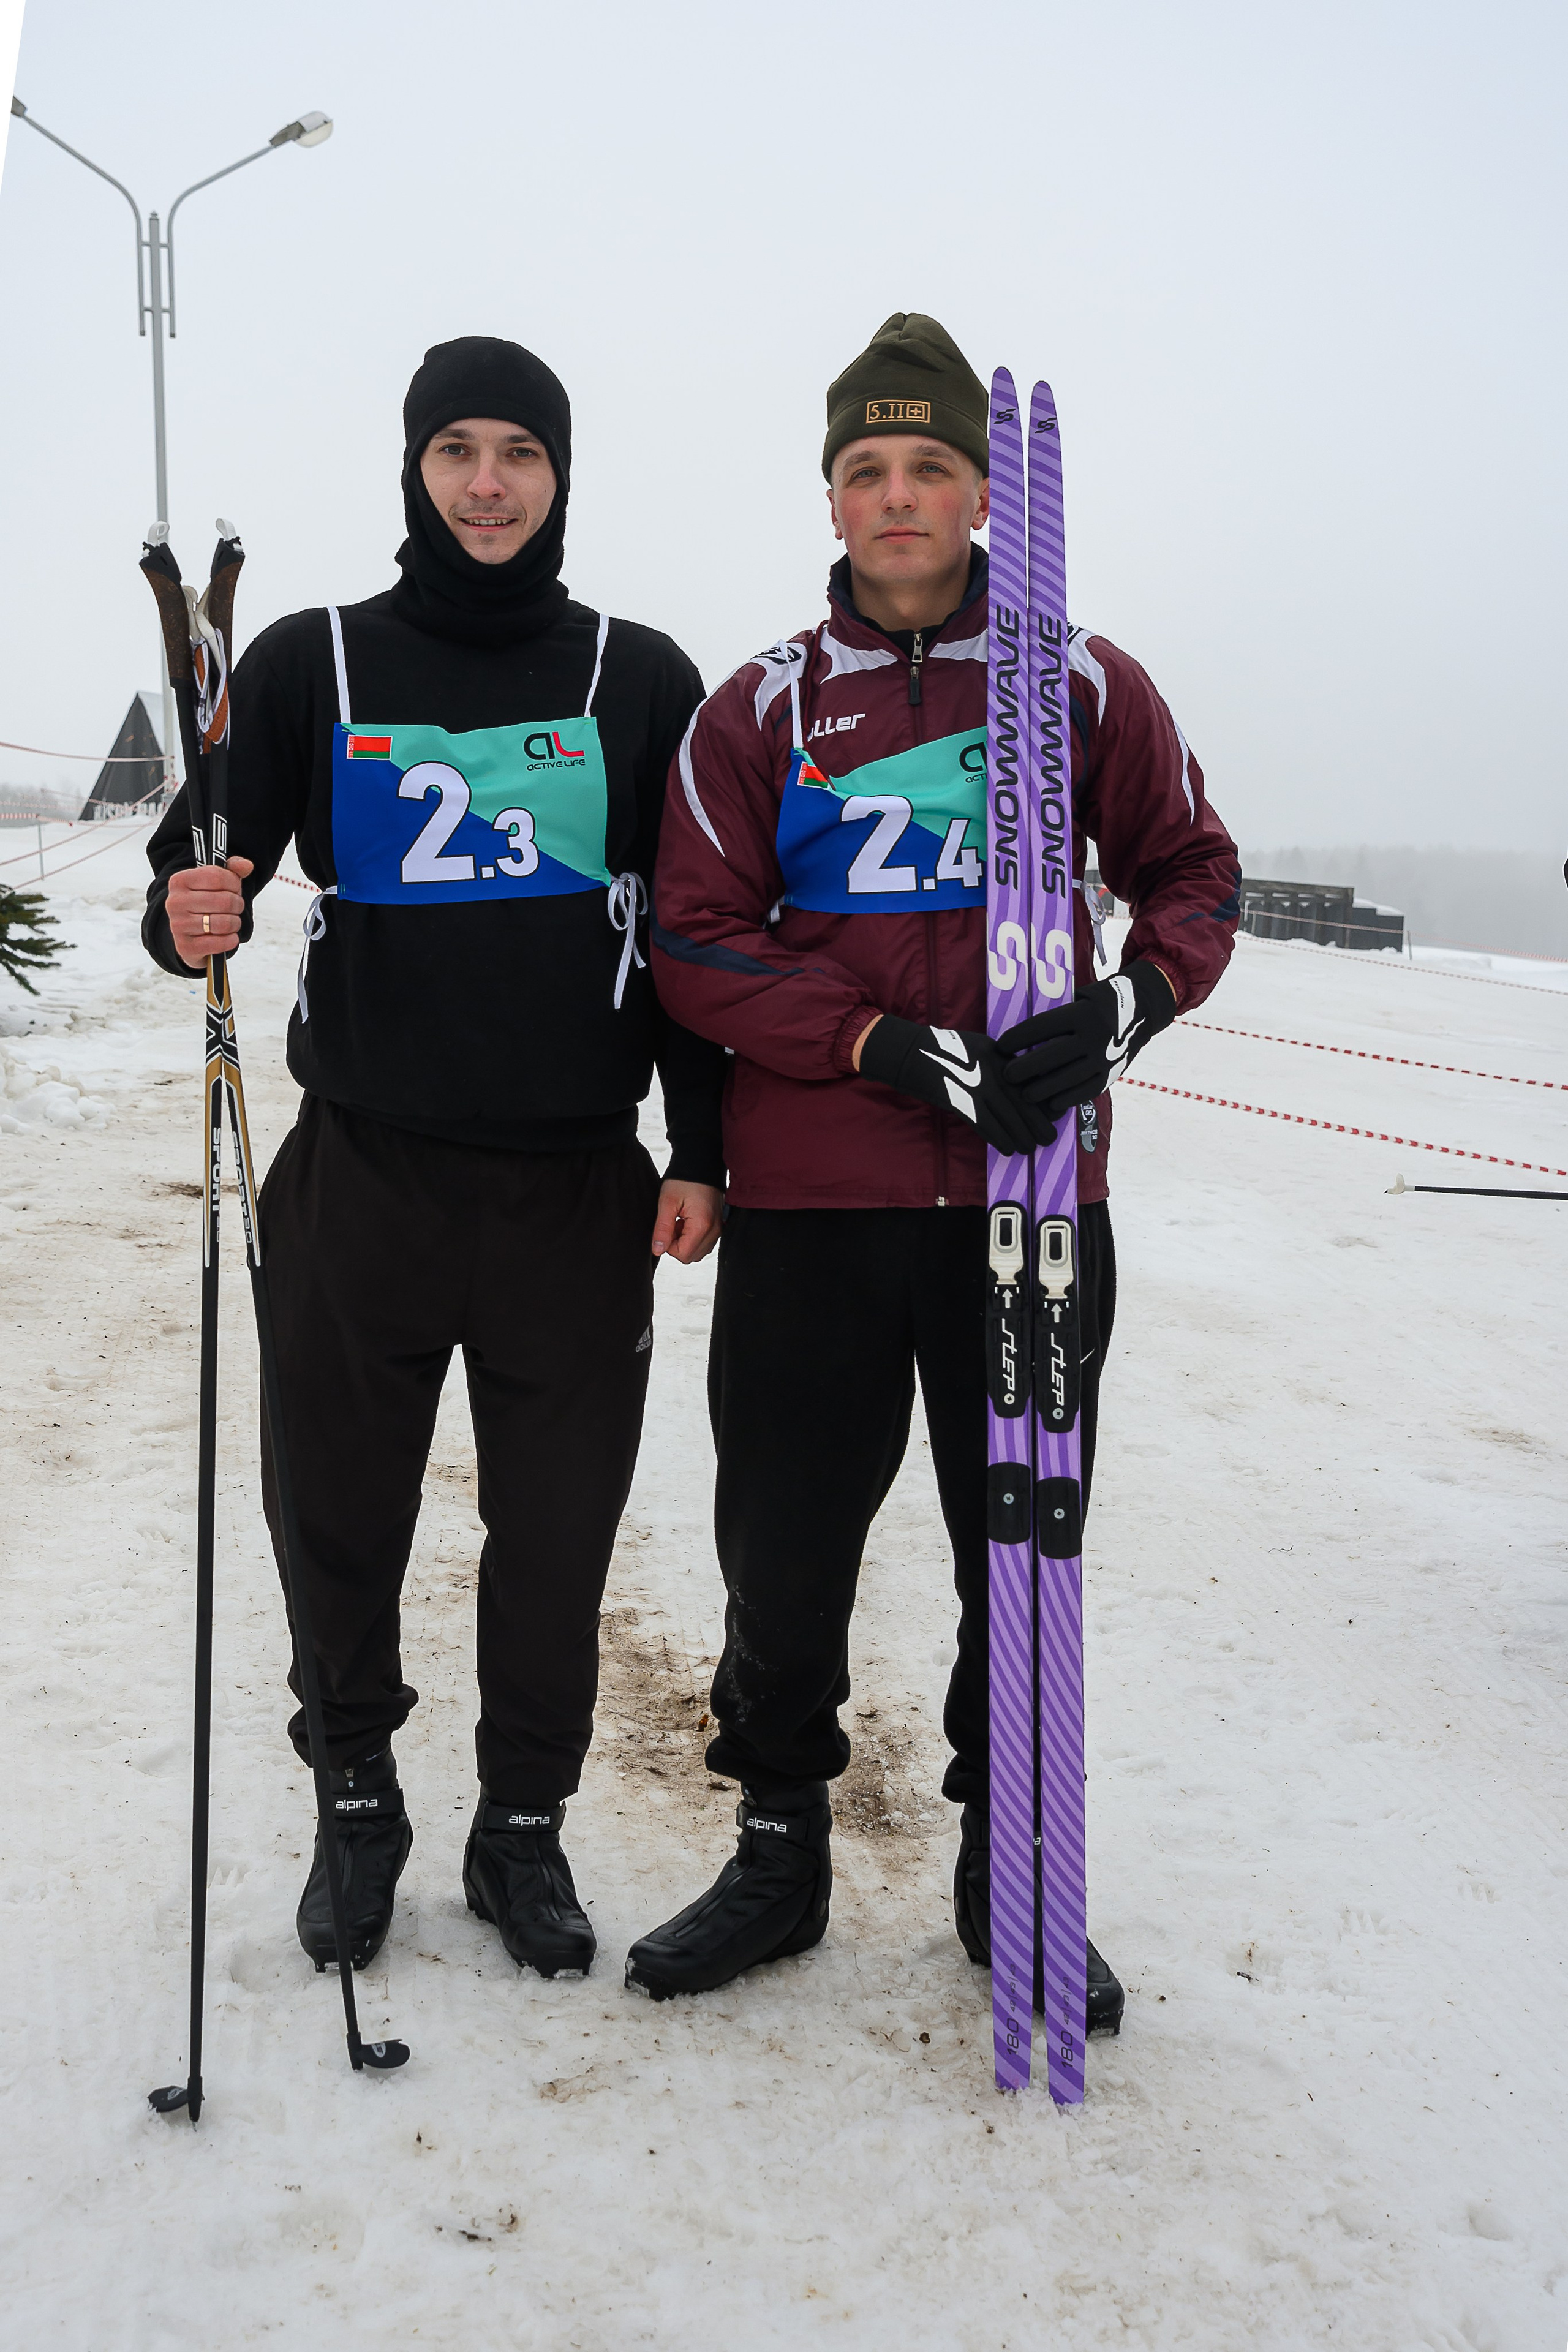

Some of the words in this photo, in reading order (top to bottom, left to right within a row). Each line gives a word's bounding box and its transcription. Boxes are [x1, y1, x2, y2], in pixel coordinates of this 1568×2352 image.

[995, 604, 1019, 891] SNOWWAVE
[1039, 612, 1066, 899] SNOWWAVE
[397, 760, 540, 884] 2.3
[839, 794, 982, 895] 2.4
[335, 1798, 379, 1812] alpina
[508, 1814, 551, 1827] alpina
[747, 1817, 788, 1833] alpina
[1006, 2018, 1019, 2056] 180
[1060, 2030, 1074, 2068] 180
